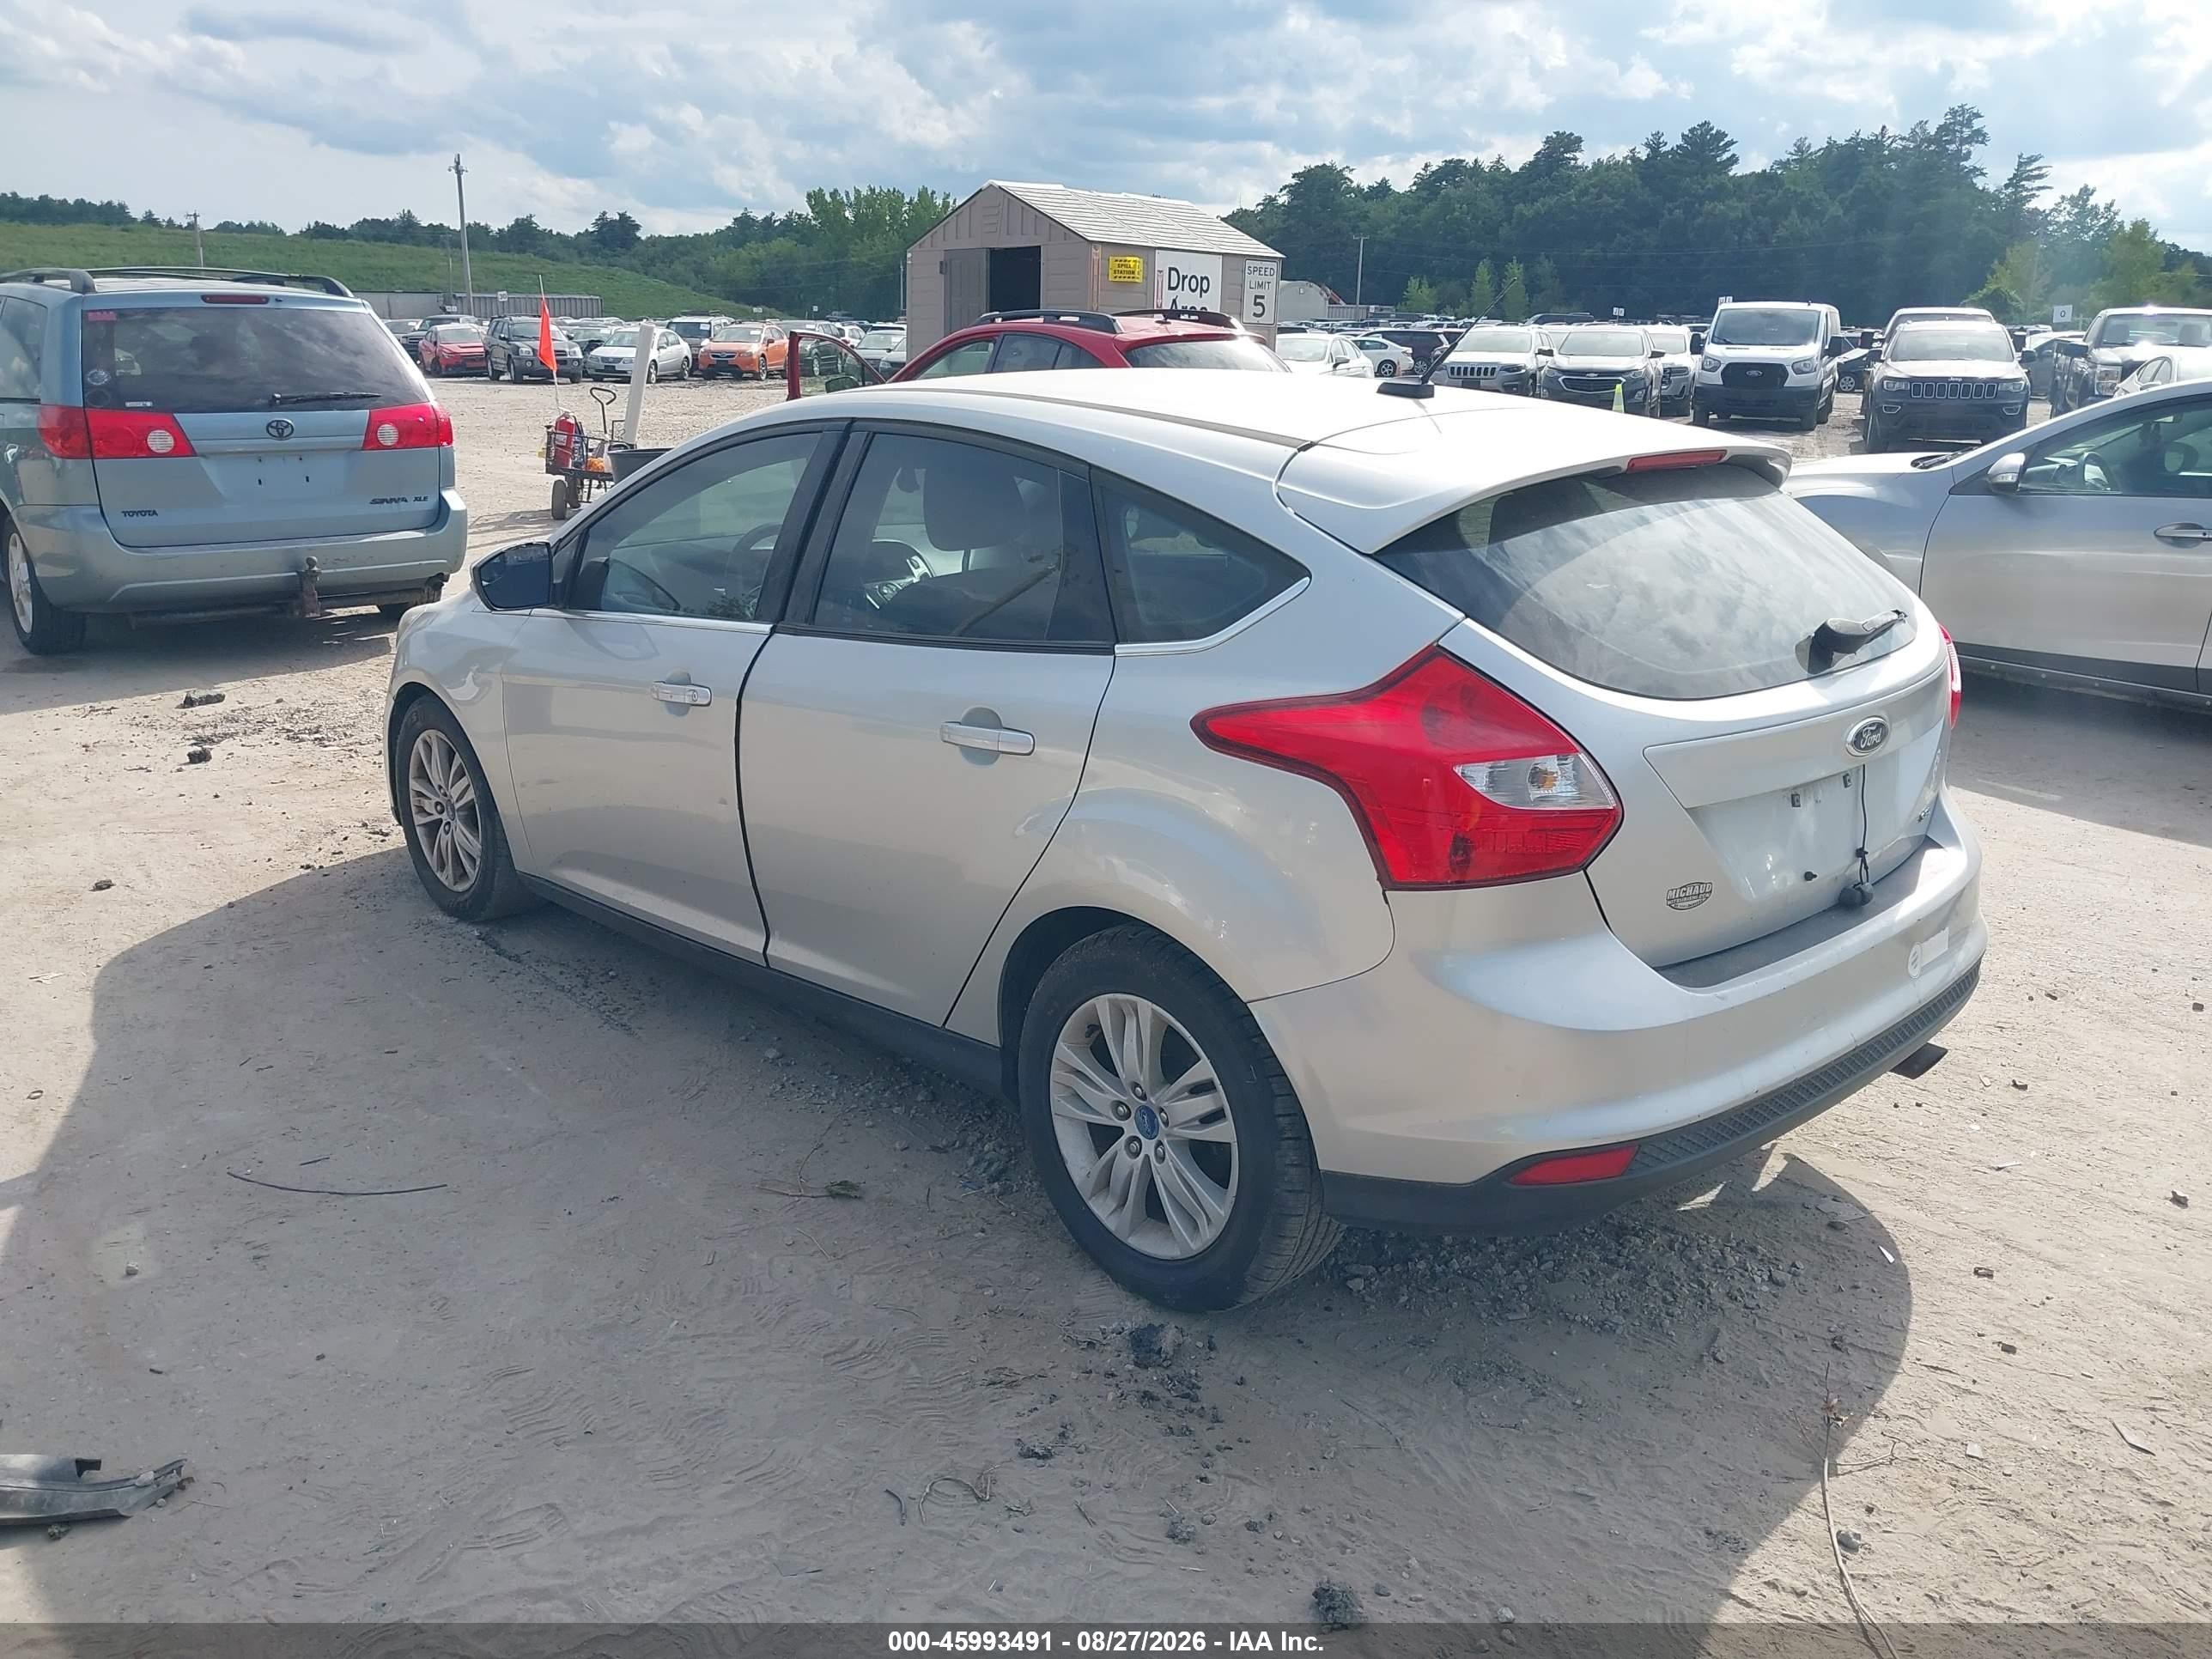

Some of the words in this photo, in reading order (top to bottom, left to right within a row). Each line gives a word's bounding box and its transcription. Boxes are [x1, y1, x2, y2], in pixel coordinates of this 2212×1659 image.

[1247, 265, 1275, 276] SPEED
[1168, 267, 1210, 298] Drop
[1249, 280, 1272, 290] LIMIT
[1252, 294, 1266, 318] 5
[1861, 725, 1882, 749] Ford
[1667, 883, 1712, 900] MICHAUD
